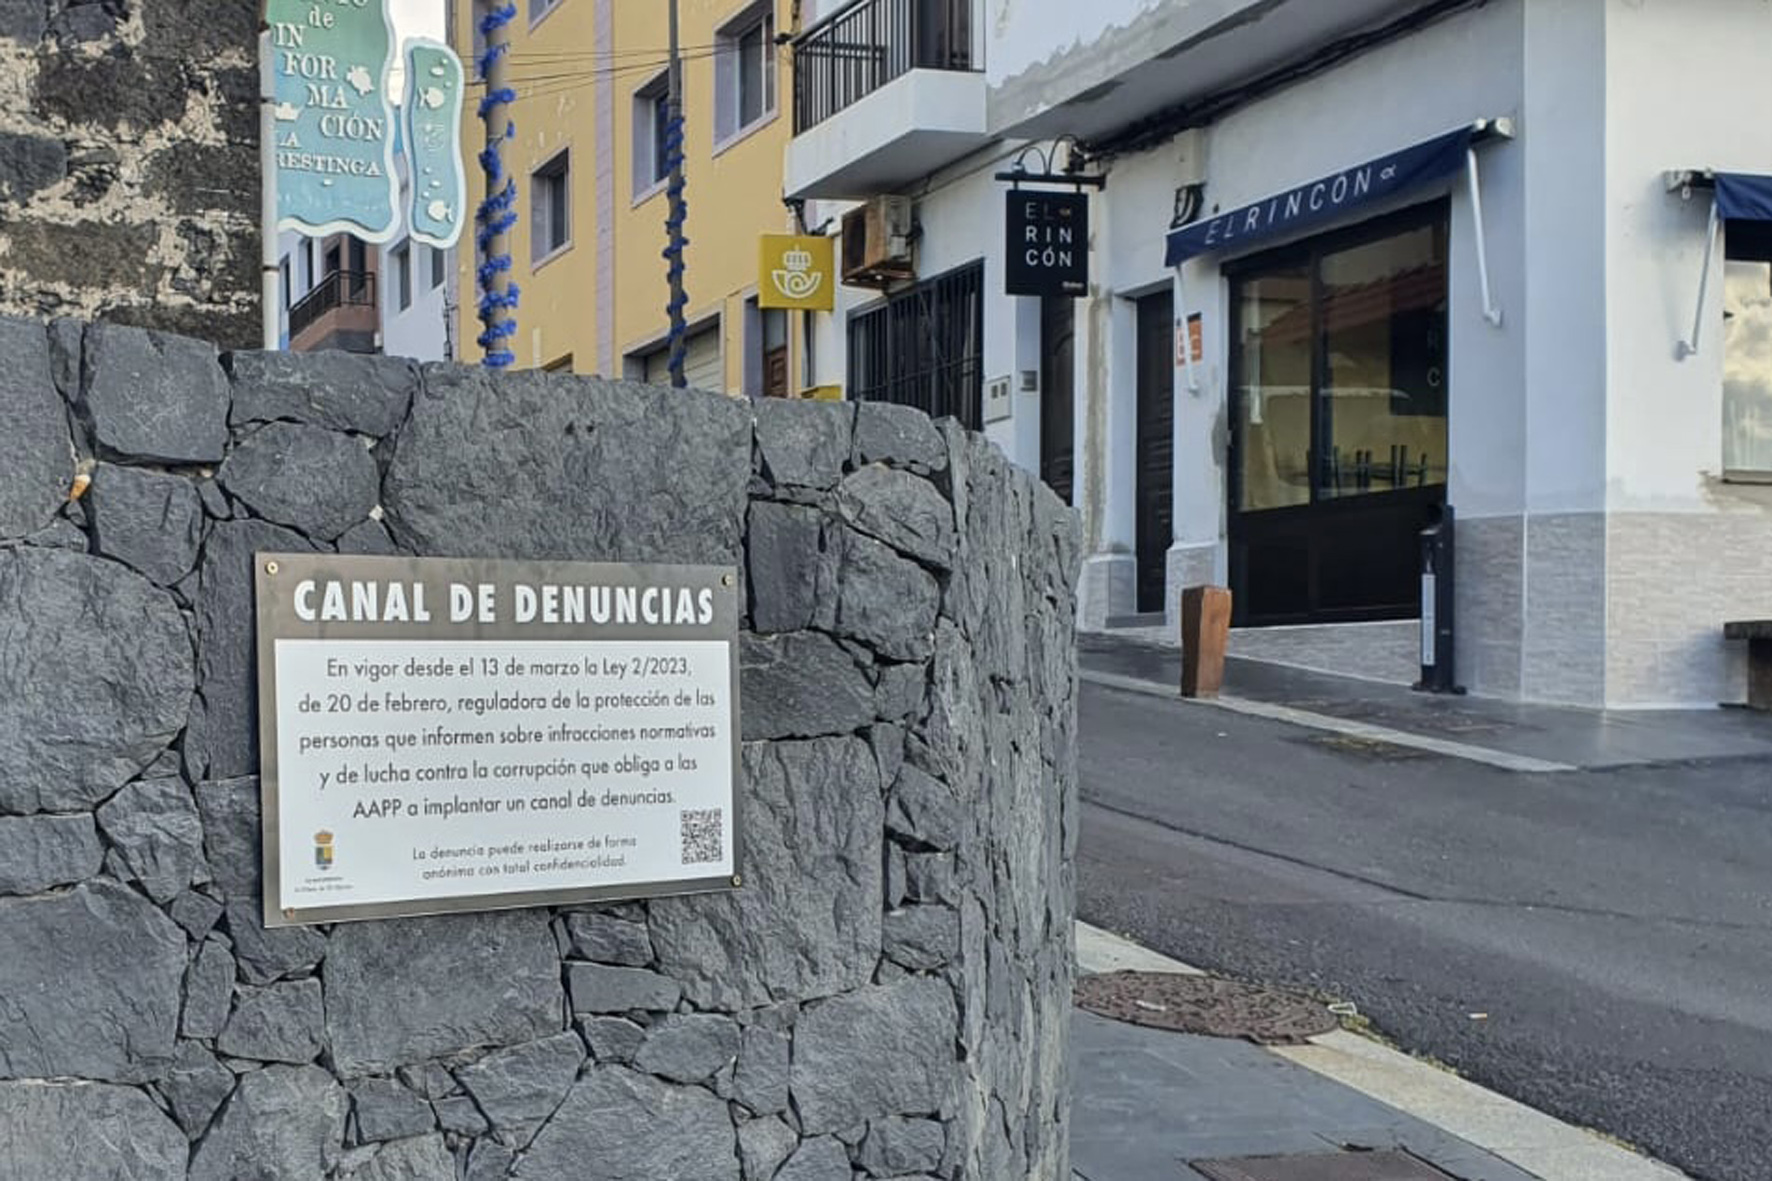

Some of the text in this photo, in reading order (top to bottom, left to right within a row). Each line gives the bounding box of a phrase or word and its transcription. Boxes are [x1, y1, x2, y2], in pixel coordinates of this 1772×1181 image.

[308, 5, 335, 28] de
[274, 22, 306, 47] IN
[283, 51, 337, 80] FOR
[306, 83, 348, 109] MA
[320, 112, 384, 140] CIÓN
[1025, 202, 1055, 221] EL
[1025, 225, 1073, 244] RIN
[1204, 214, 1234, 245] EL
[1025, 245, 1073, 267] CÓN
[293, 579, 714, 625] CANAL DE DENUNCIAS
[326, 656, 693, 682] En vigor desde el 13 de marzo la Ley 2/2023,
[297, 687, 717, 717] de 20 de febrero, reguladora de la protección de las
[299, 720, 717, 755] personas que informen sobre infracciones normativas
[318, 752, 698, 791] y de lucha contra la corrupción que obliga a las
[352, 787, 678, 820] AAPP a implantar un canal de denuncias.
[412, 834, 638, 861] La denuncia puede realizarse de forma
[422, 862, 475, 881] anónima
[477, 864, 501, 878] con
[503, 859, 531, 875] total
